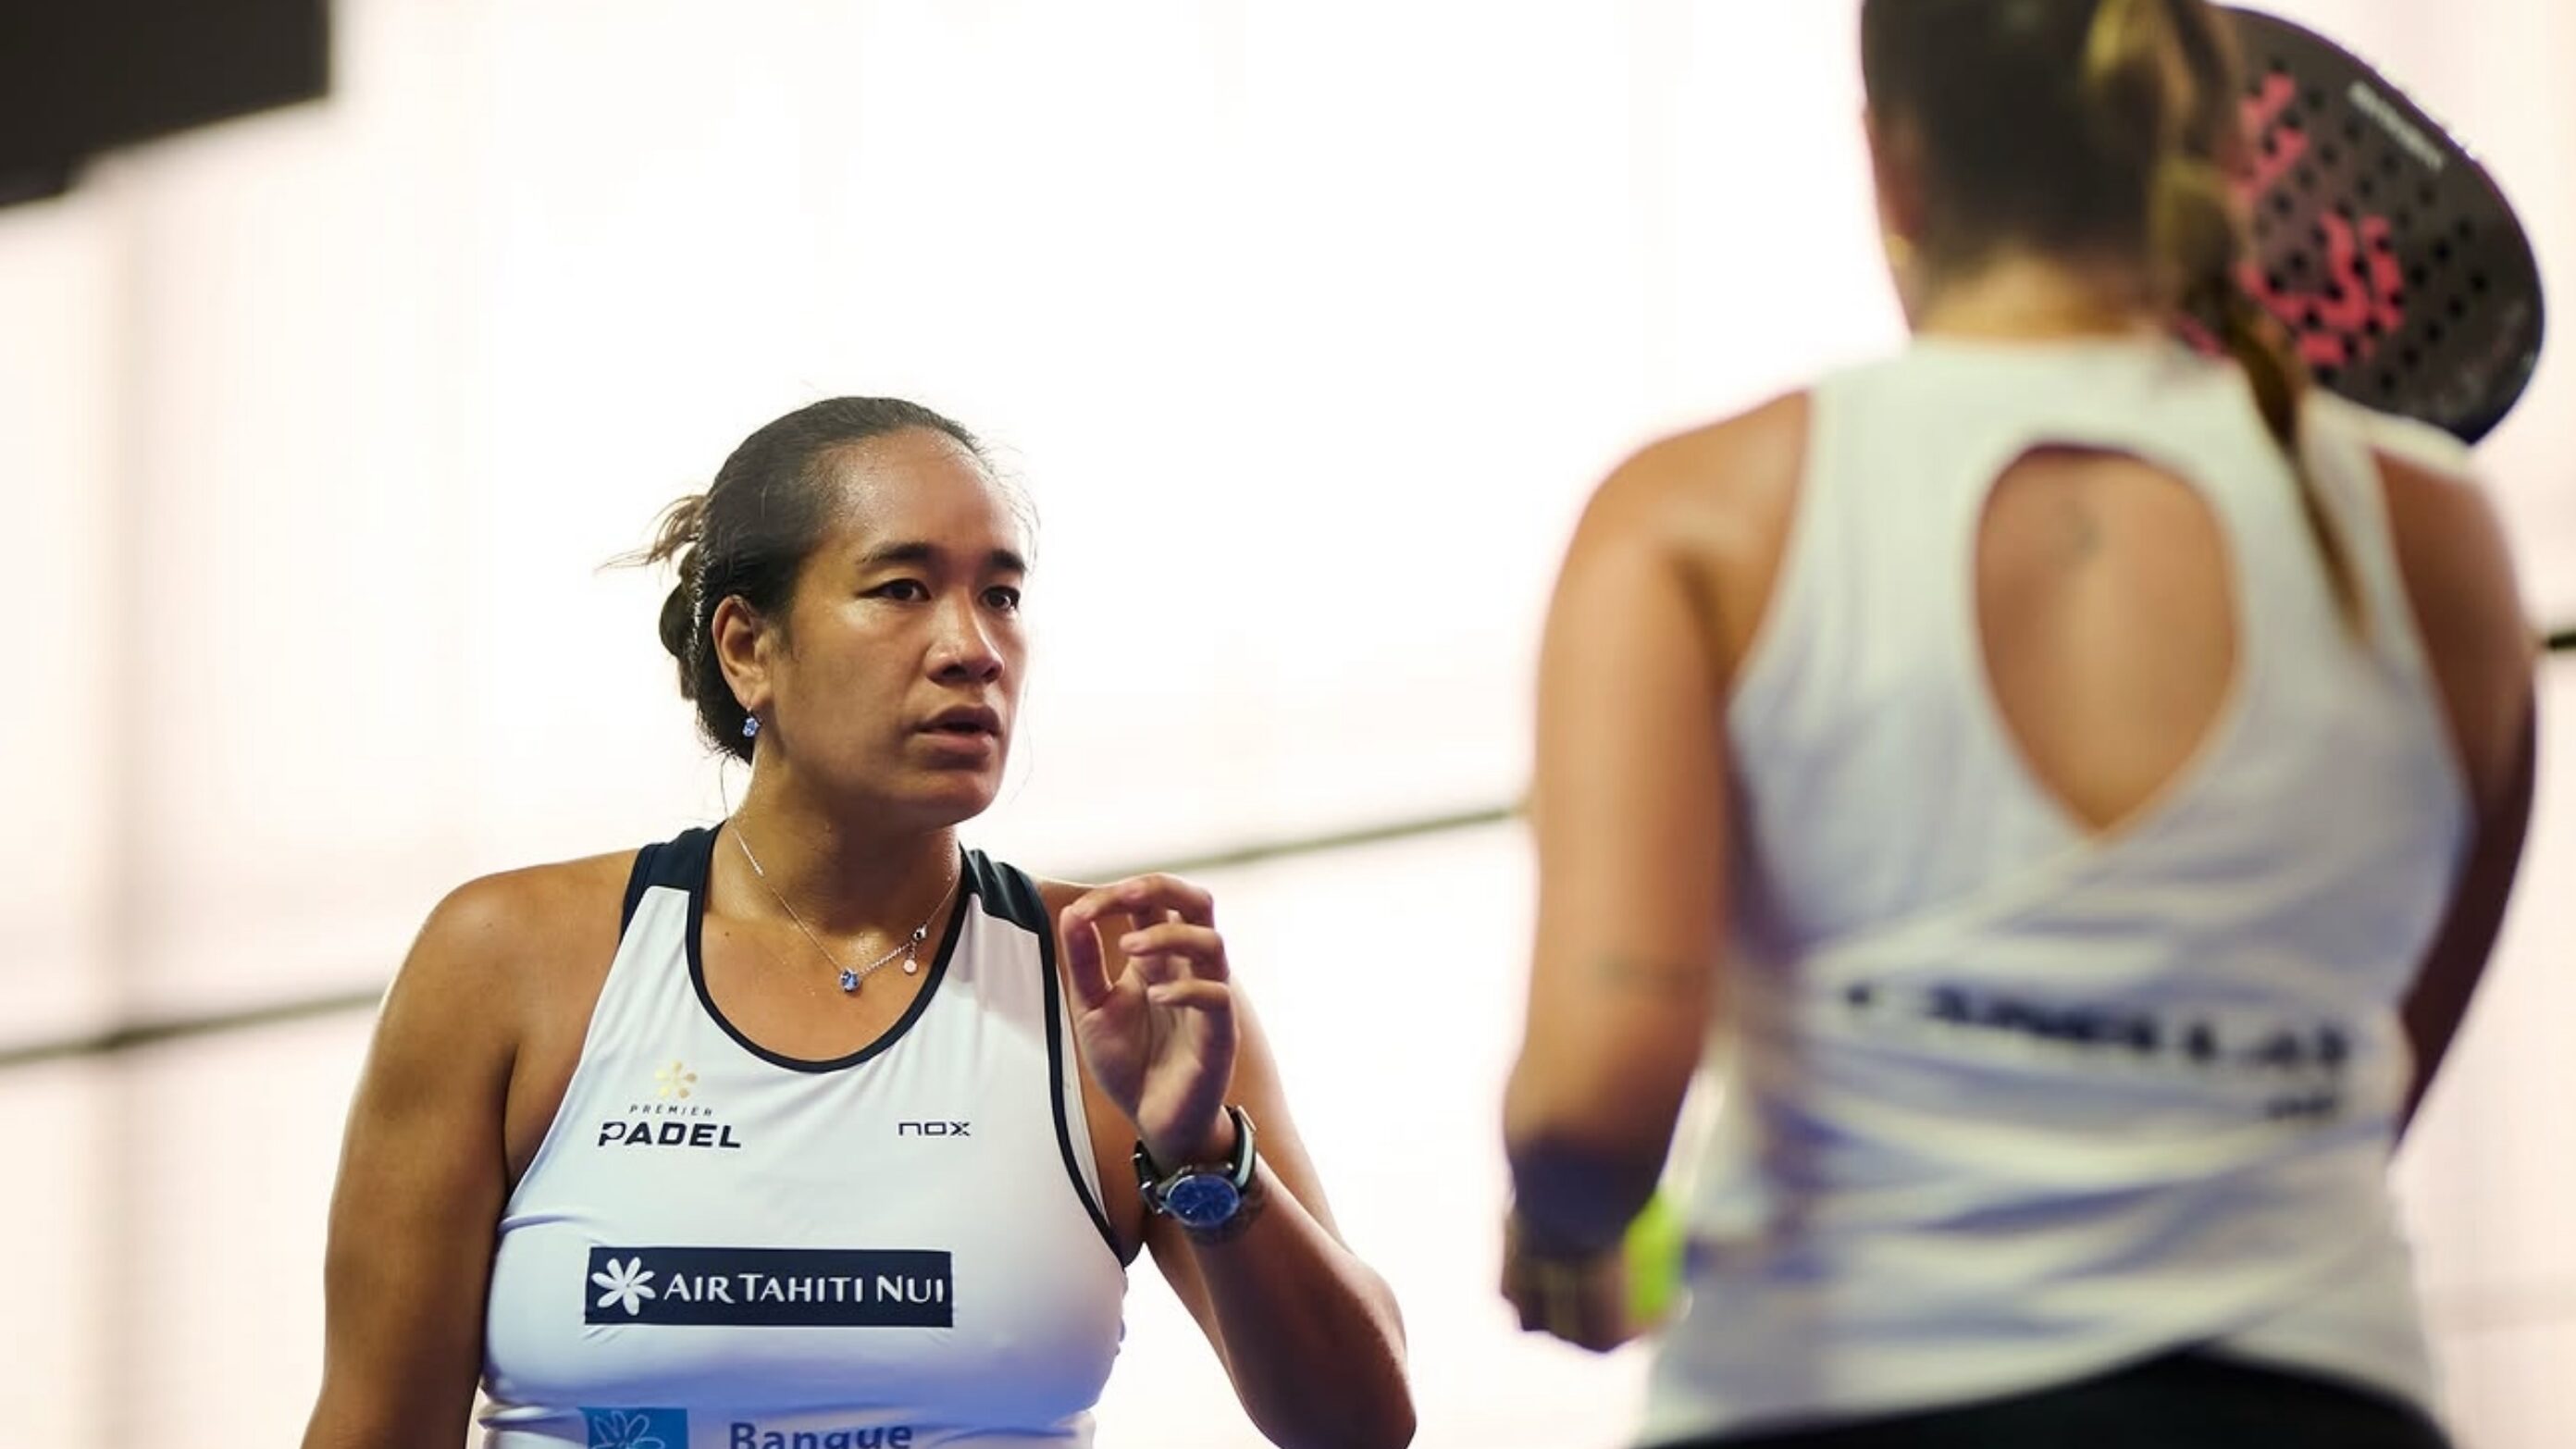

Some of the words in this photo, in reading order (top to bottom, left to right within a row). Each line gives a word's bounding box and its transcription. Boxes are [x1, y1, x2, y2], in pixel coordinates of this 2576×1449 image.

[629, 1104, 712, 1116] PREMIER
[598, 1121, 741, 1148] PADEL
[663, 1273, 736, 1304] AIR
[737, 1273, 863, 1303] TAHITI
[876, 1275, 944, 1303] NUI
